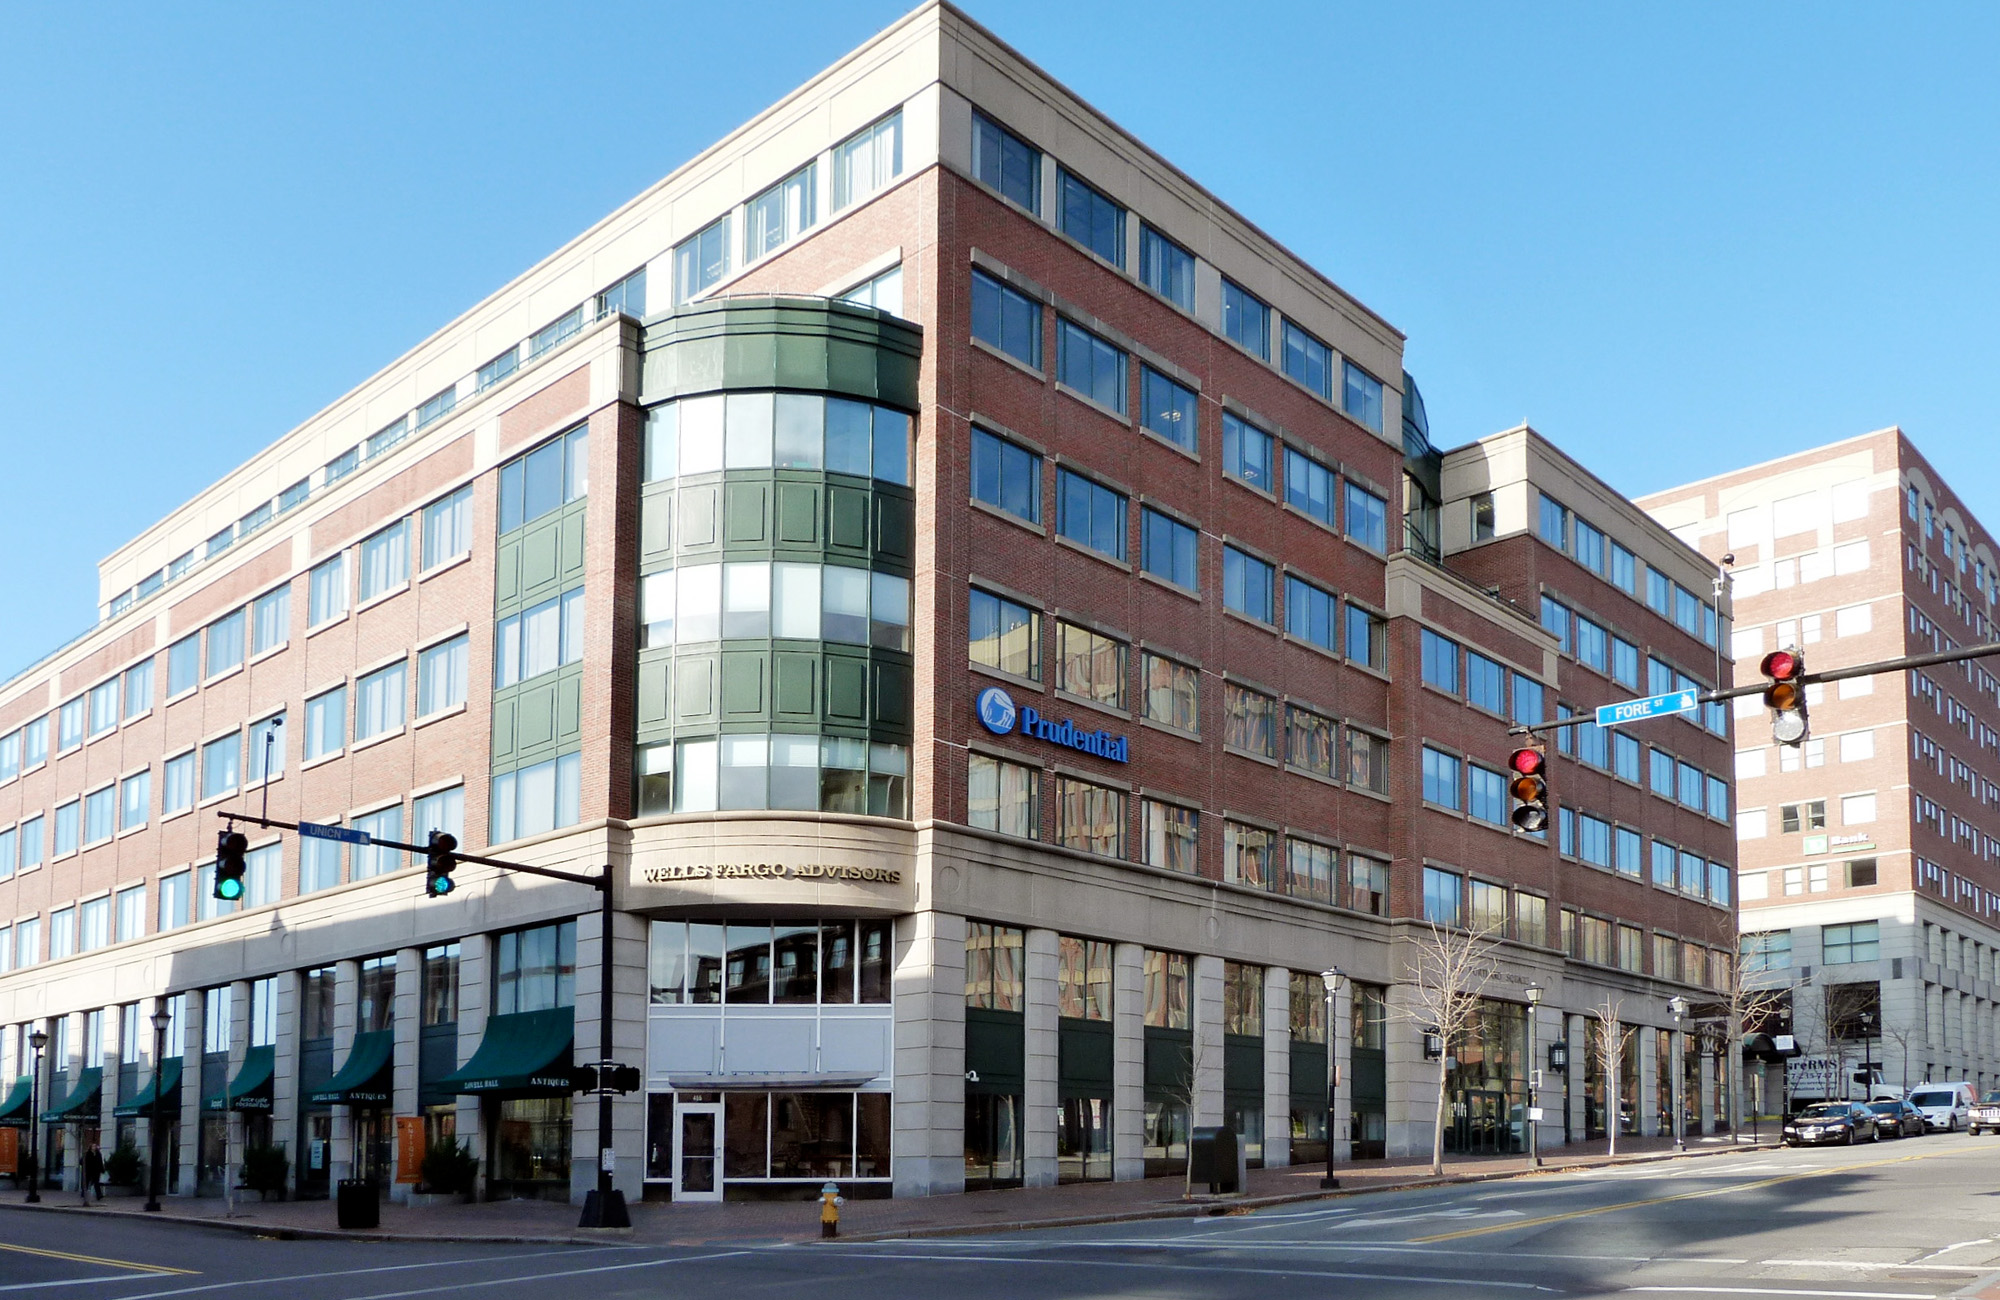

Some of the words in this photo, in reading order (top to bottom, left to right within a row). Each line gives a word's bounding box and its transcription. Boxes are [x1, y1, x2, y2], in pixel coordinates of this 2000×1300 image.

[1615, 701, 1652, 720] FORE
[1653, 698, 1664, 707] ST
[1020, 705, 1129, 764] Prudential
[645, 864, 709, 883] WELLS
[714, 862, 788, 879] FARGO
[792, 863, 901, 884] ADVISORS
[349, 1092, 387, 1100] ANTIQUES
